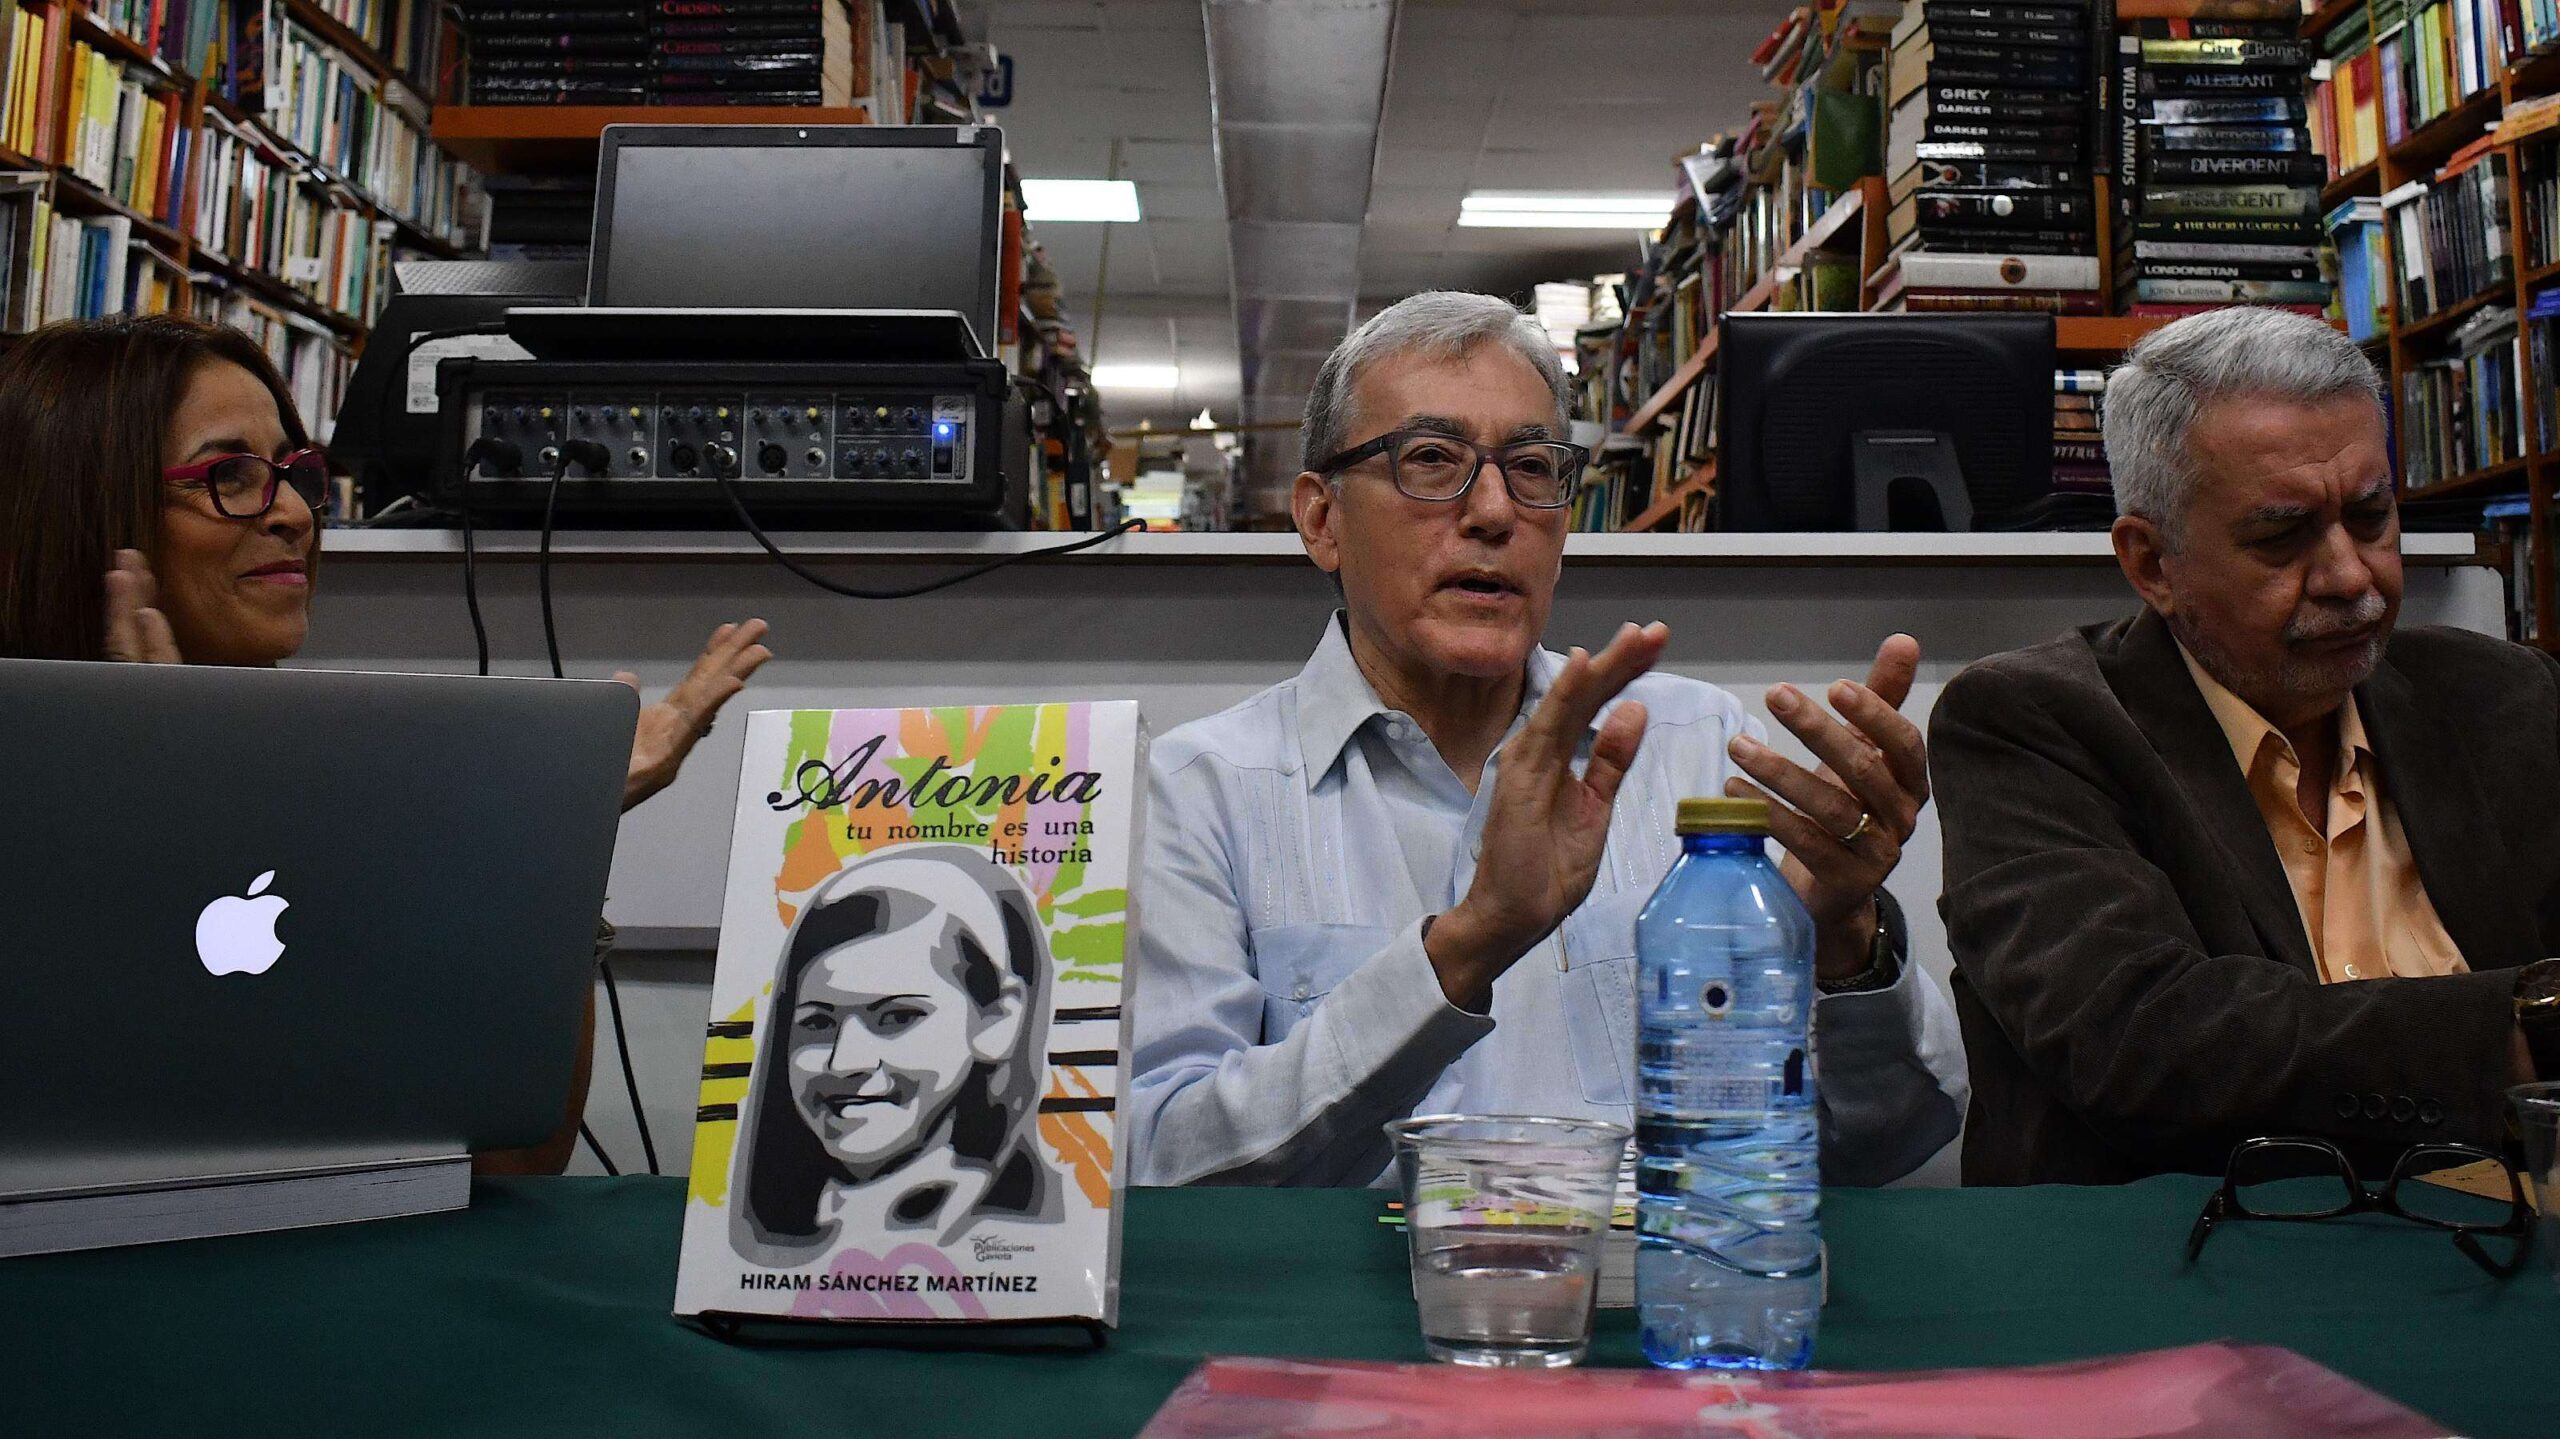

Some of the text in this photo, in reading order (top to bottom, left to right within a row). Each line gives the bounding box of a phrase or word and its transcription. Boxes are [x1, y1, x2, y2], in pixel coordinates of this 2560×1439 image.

[2255, 41, 2304, 58] Bones
[2122, 66, 2137, 110] WILD
[2184, 74, 2274, 88] ALLEGIANT
[1940, 88, 1990, 101] GREY
[1936, 103, 1992, 116] DARKER
[1933, 124, 1989, 137] DARKER
[2121, 116, 2137, 186] ANIMUS
[2190, 157, 2290, 174] DIVERGENT
[2180, 191, 2285, 210] INSURGENT
[2144, 265, 2239, 278] LONDONISTAN
[767, 734, 1102, 811] Antonia
[846, 812, 1094, 840] tu nombre es una
[991, 838, 1093, 865] historia
[740, 1270, 1038, 1293] HIRAM SÁNCHEZ MARTÍNEZ
